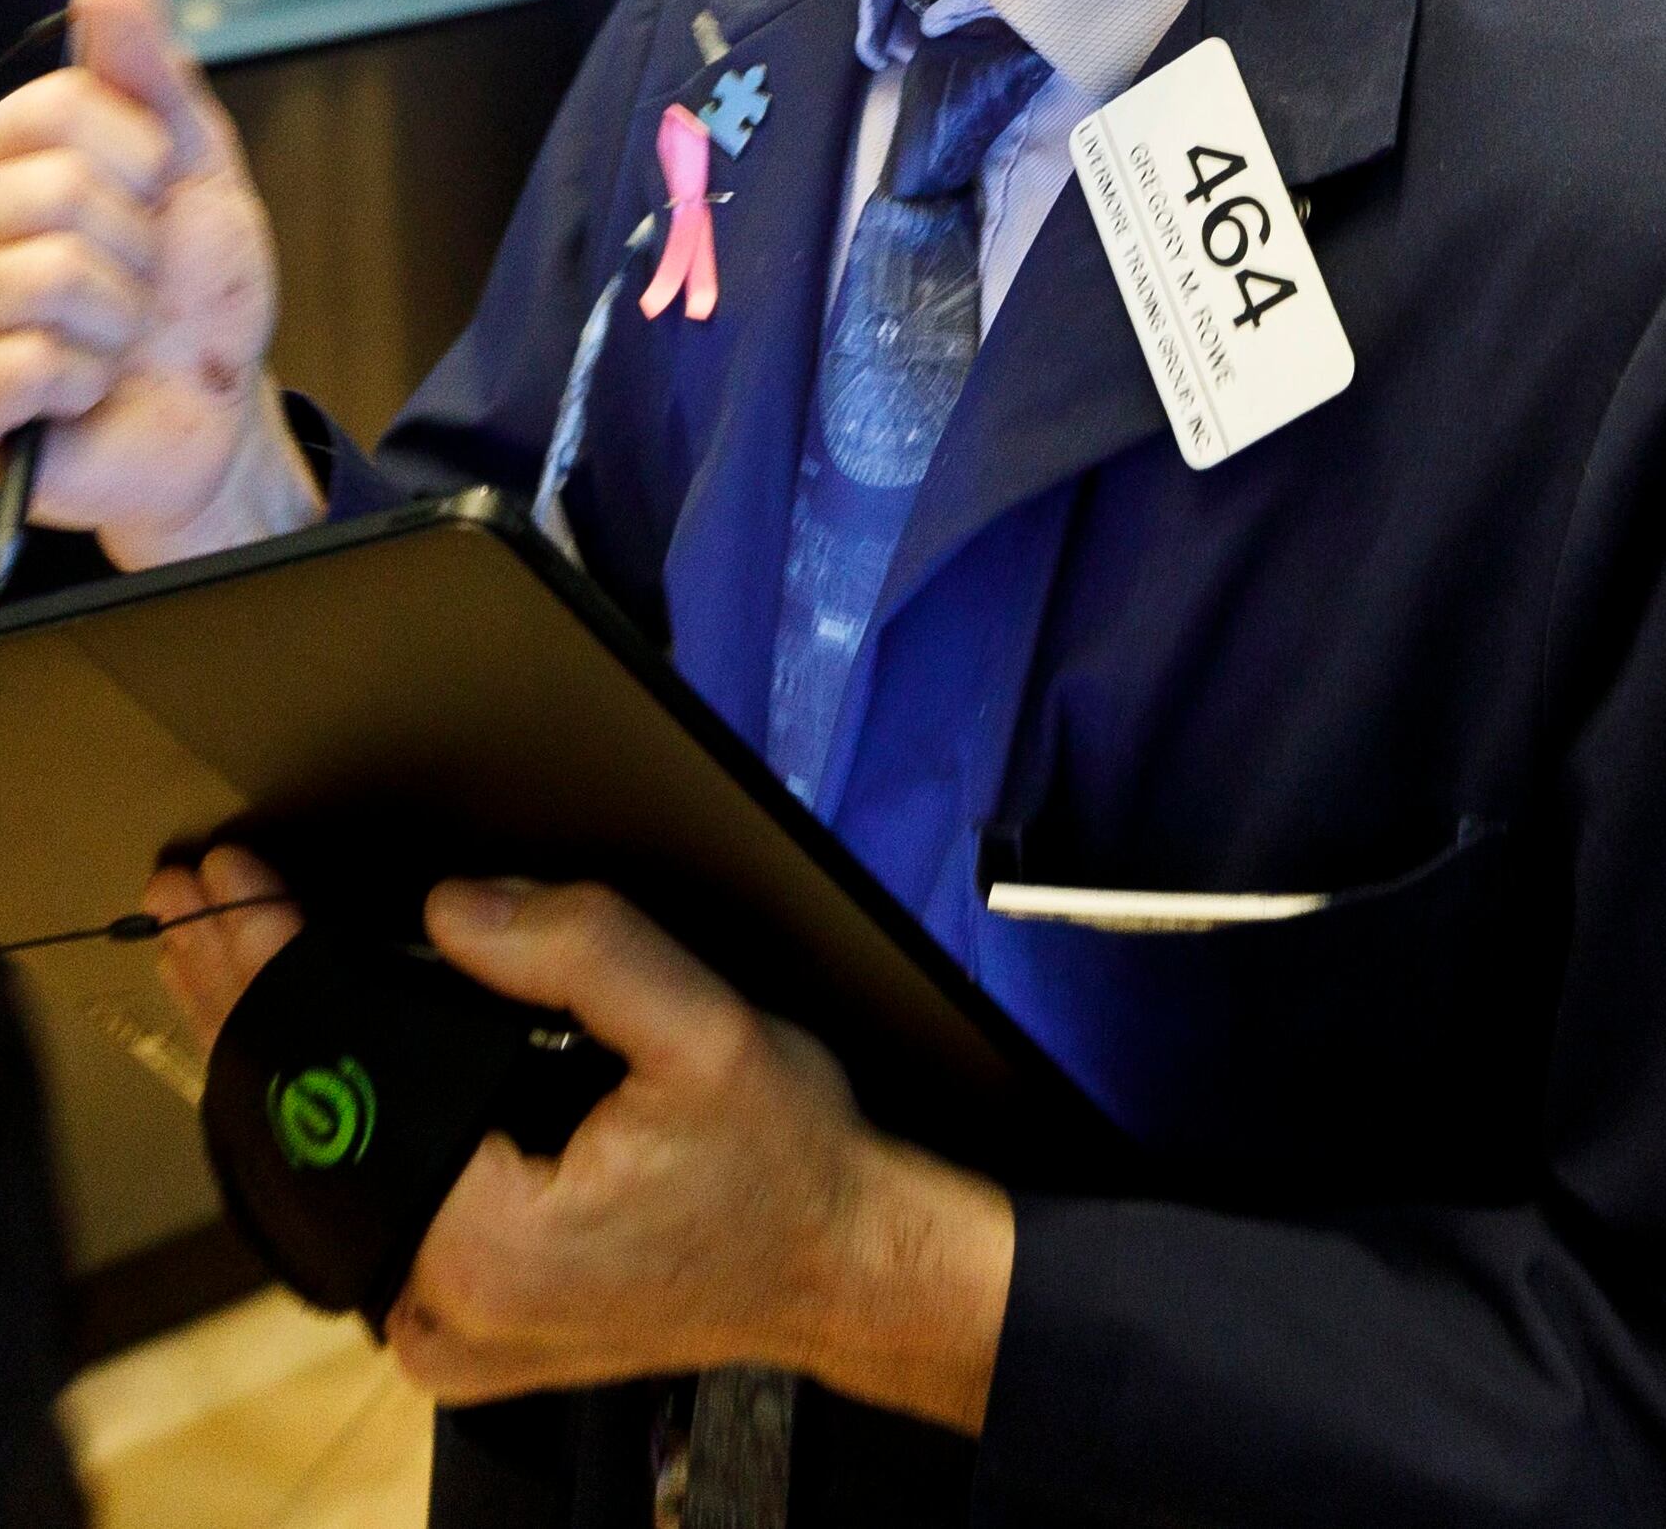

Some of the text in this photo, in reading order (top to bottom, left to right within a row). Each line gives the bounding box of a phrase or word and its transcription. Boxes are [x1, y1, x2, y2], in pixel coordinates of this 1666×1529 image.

[1077, 122, 1129, 239] LIVERMORE
[1123, 244, 1167, 334] TRADING
[1129, 141, 1187, 261] GREGORY
[1192, 306, 1237, 392] ROWE
[1184, 145, 1298, 329] 464
